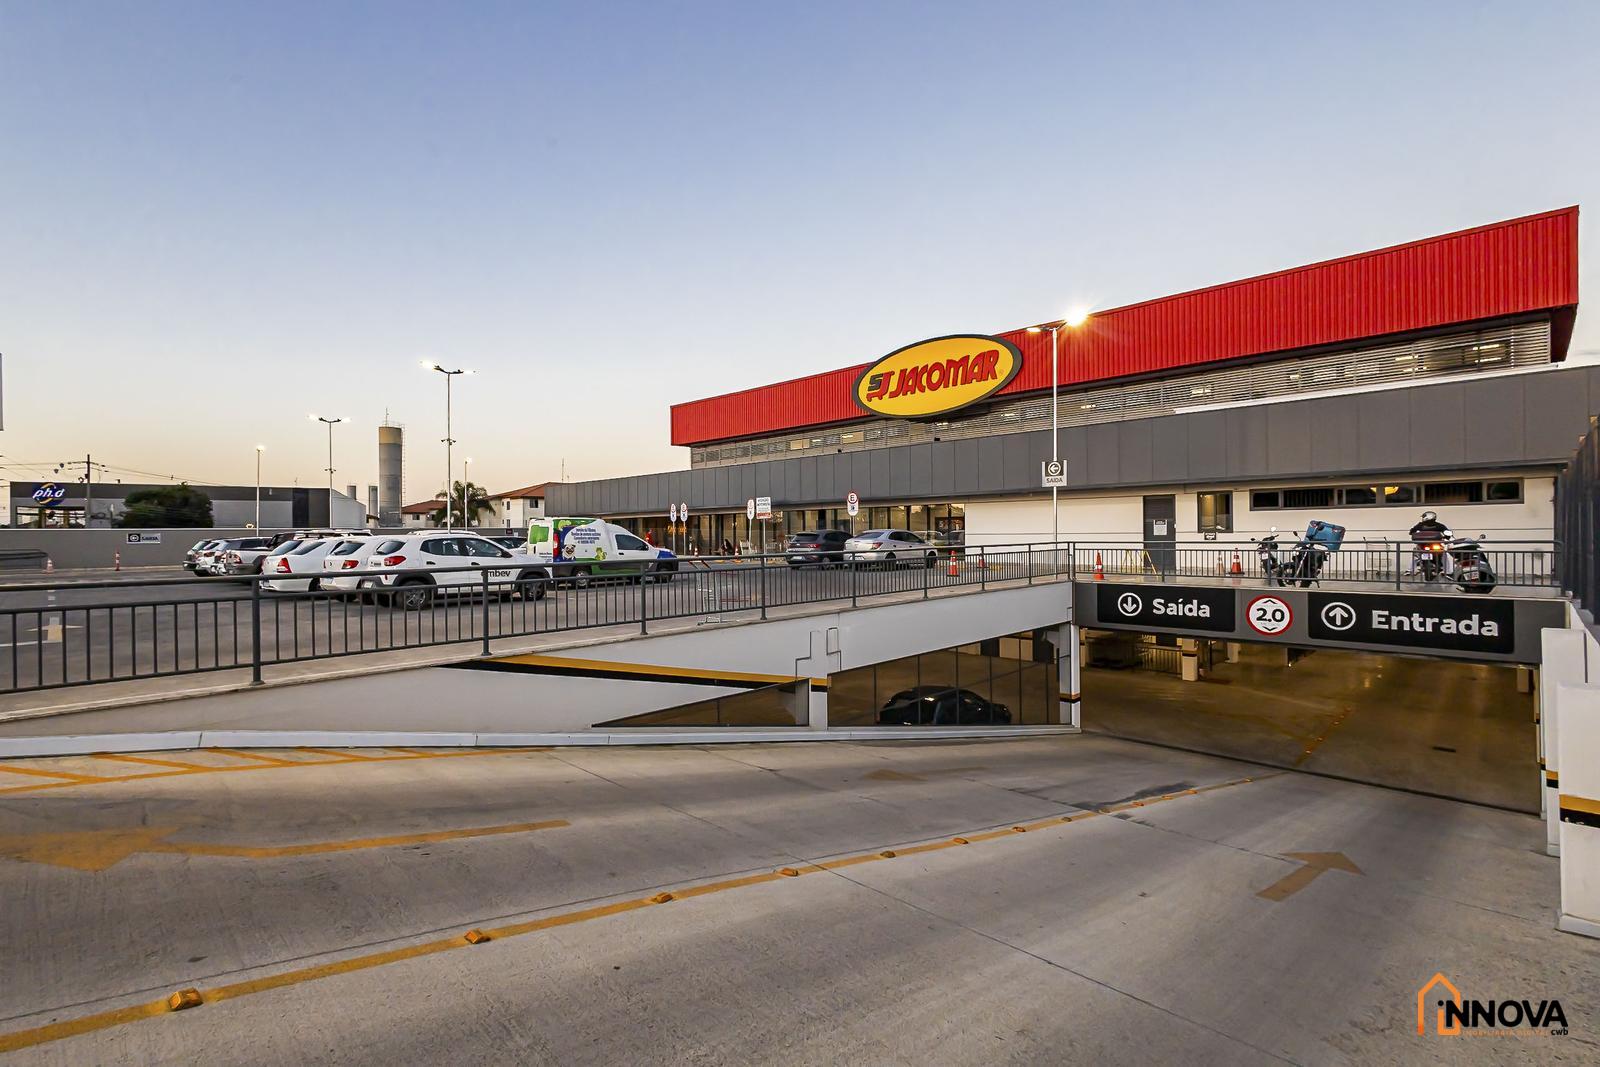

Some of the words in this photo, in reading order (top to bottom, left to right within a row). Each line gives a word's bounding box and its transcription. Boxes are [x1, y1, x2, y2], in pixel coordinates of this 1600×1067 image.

[889, 349, 1000, 399] JACOMAR
[1152, 598, 1211, 618] Saída
[1256, 607, 1285, 623] 2.0
[1371, 609, 1499, 637] Entrada
